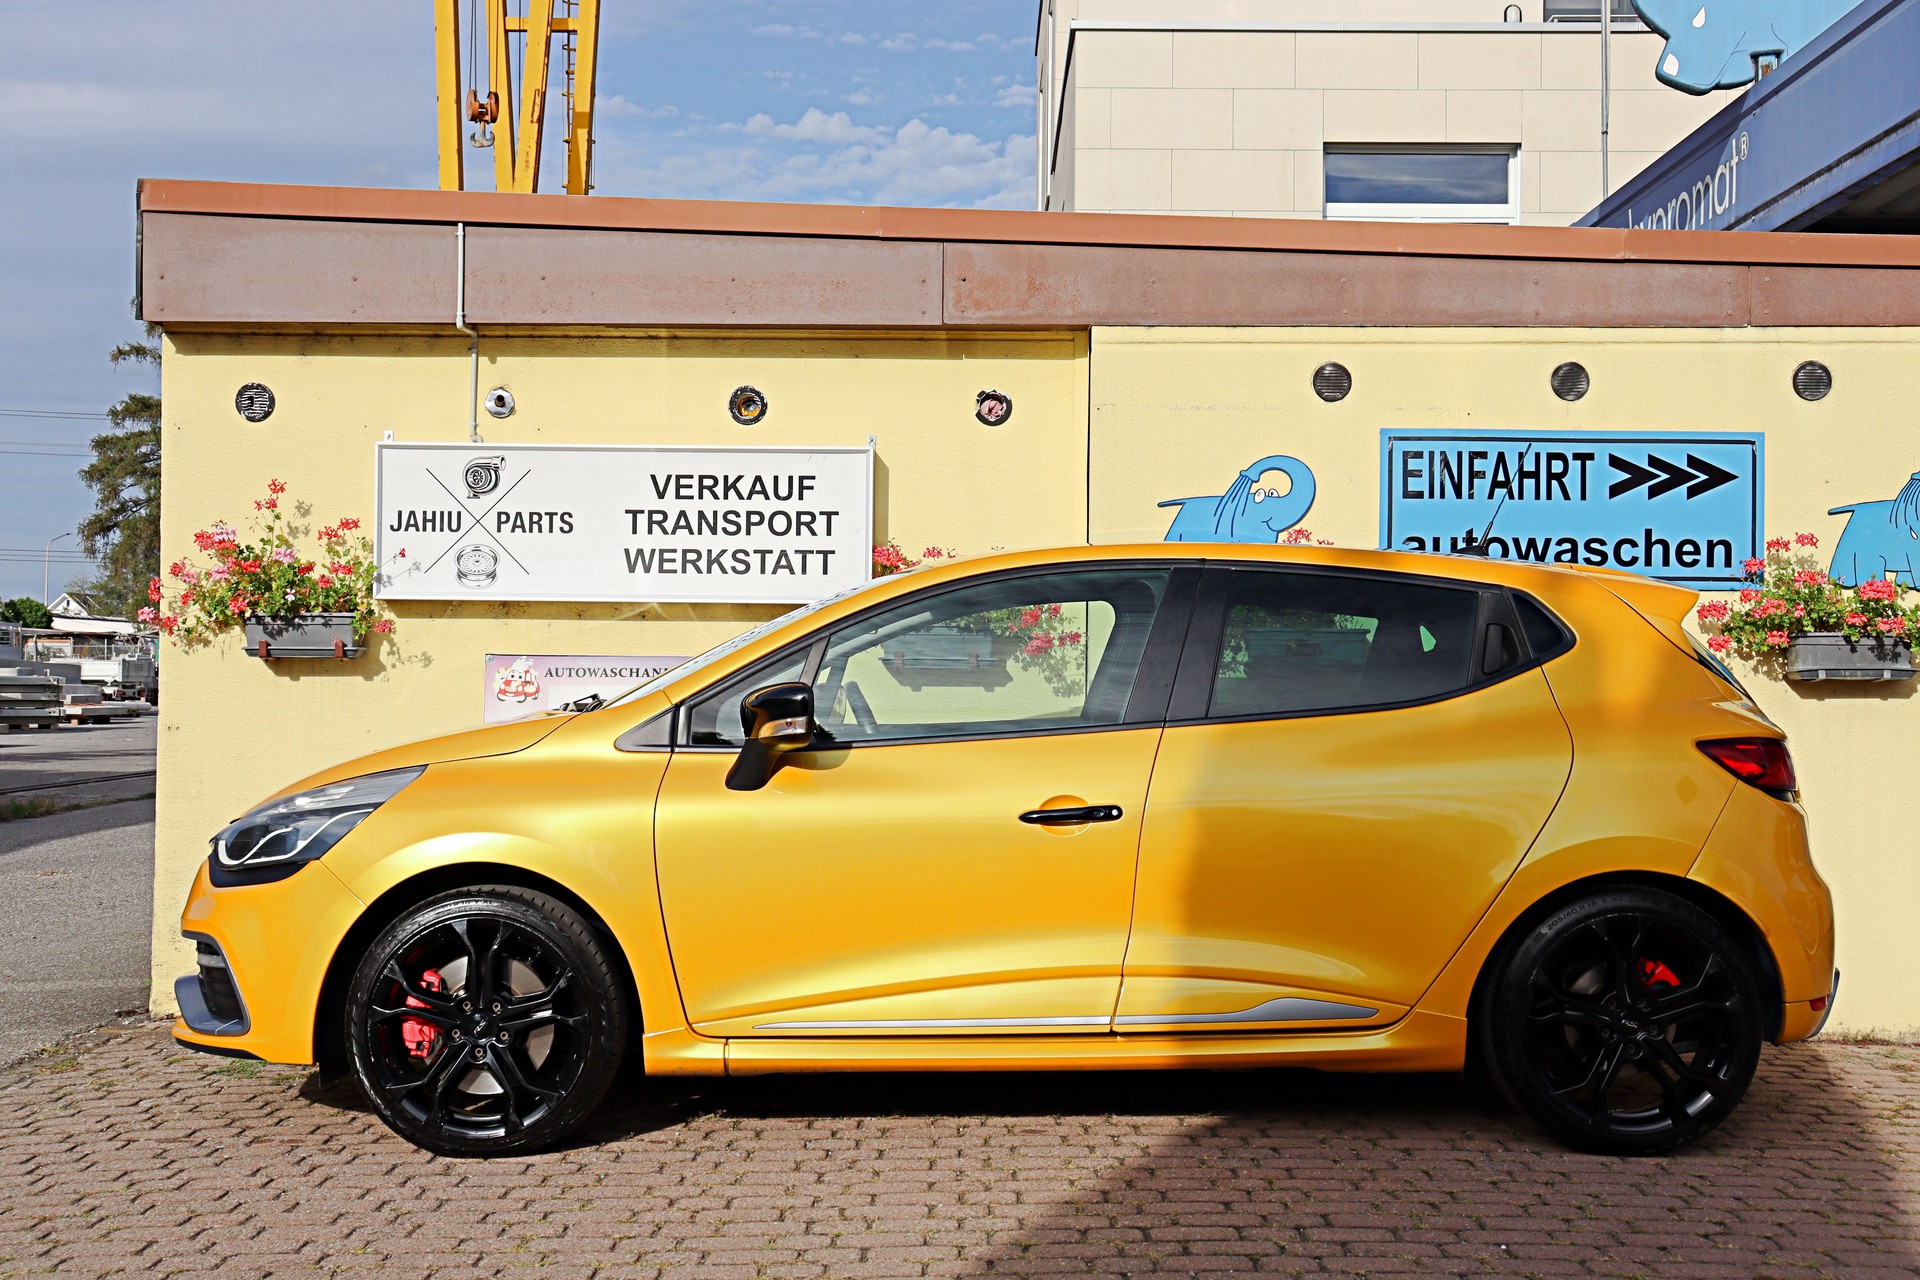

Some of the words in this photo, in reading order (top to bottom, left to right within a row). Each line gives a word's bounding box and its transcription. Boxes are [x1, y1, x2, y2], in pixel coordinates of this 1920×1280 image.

[650, 474, 816, 501] VERKAUF
[1402, 450, 1596, 501] EINFAHRT
[389, 511, 463, 533] JAHIU
[496, 511, 574, 534] PARTS
[624, 509, 840, 537] TRANSPORT
[623, 548, 836, 576] WERKSTATT
[543, 667, 669, 679] AUTOWASCHAN
[1546, 907, 1578, 930] 205/40
